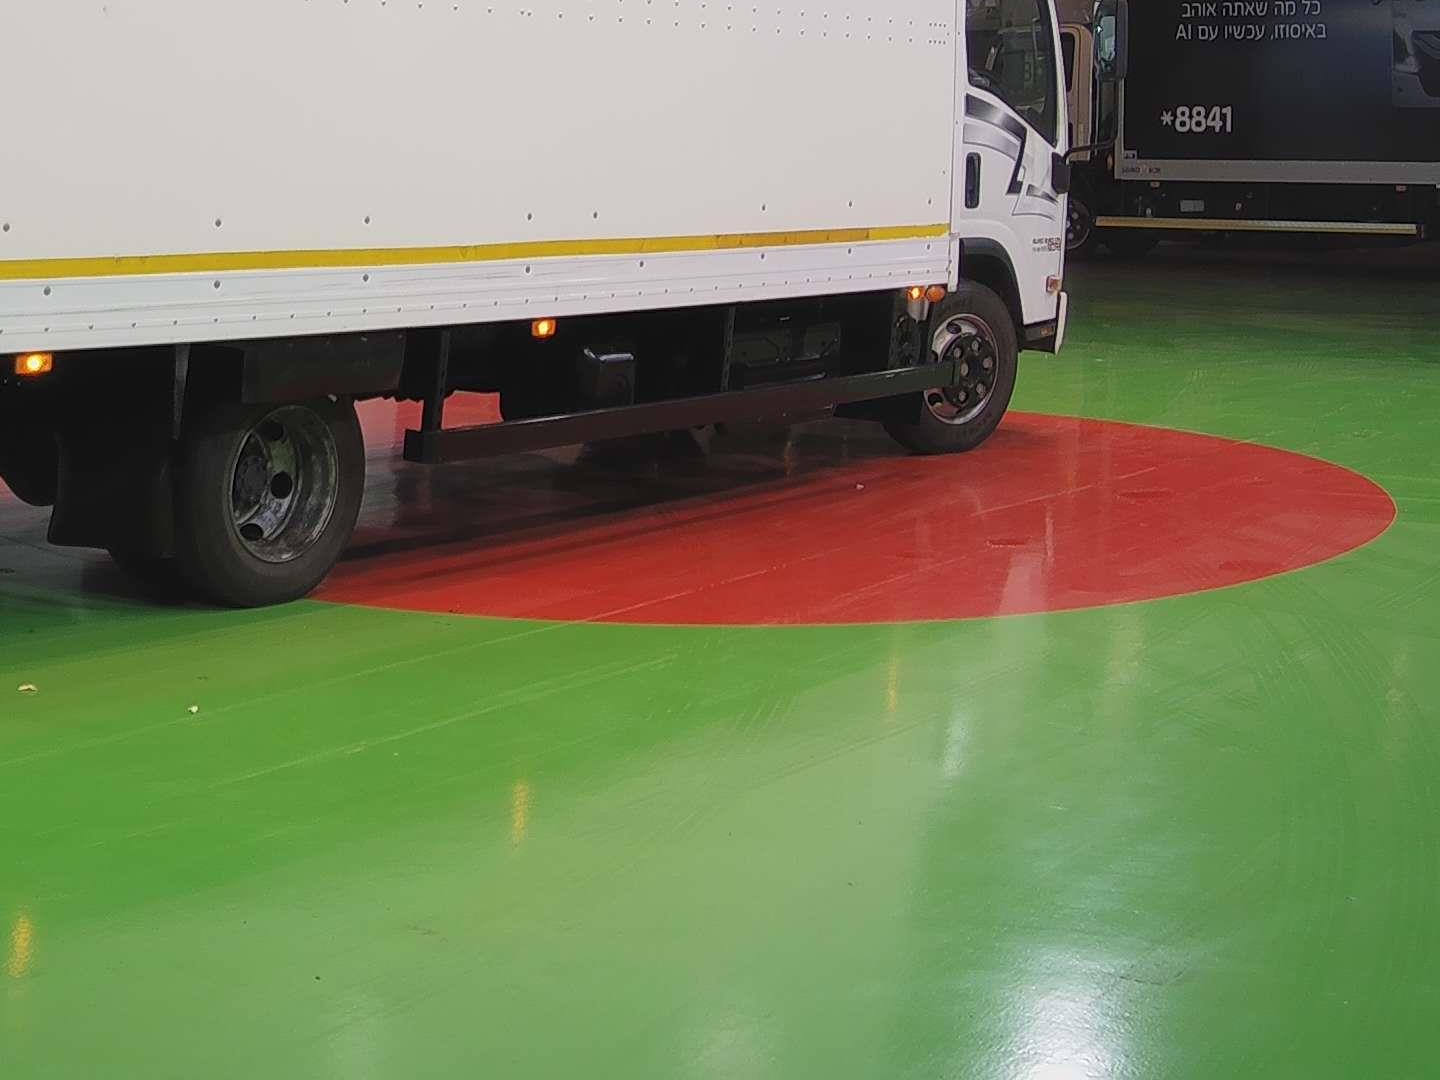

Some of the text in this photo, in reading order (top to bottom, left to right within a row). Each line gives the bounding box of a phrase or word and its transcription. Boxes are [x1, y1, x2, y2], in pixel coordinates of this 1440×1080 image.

[1181, 1, 1217, 17] אוהב
[1222, 0, 1268, 17] שאתה
[1274, 0, 1296, 16] מה
[1175, 23, 1327, 40] באיסוזו, עכשיו עם AI
